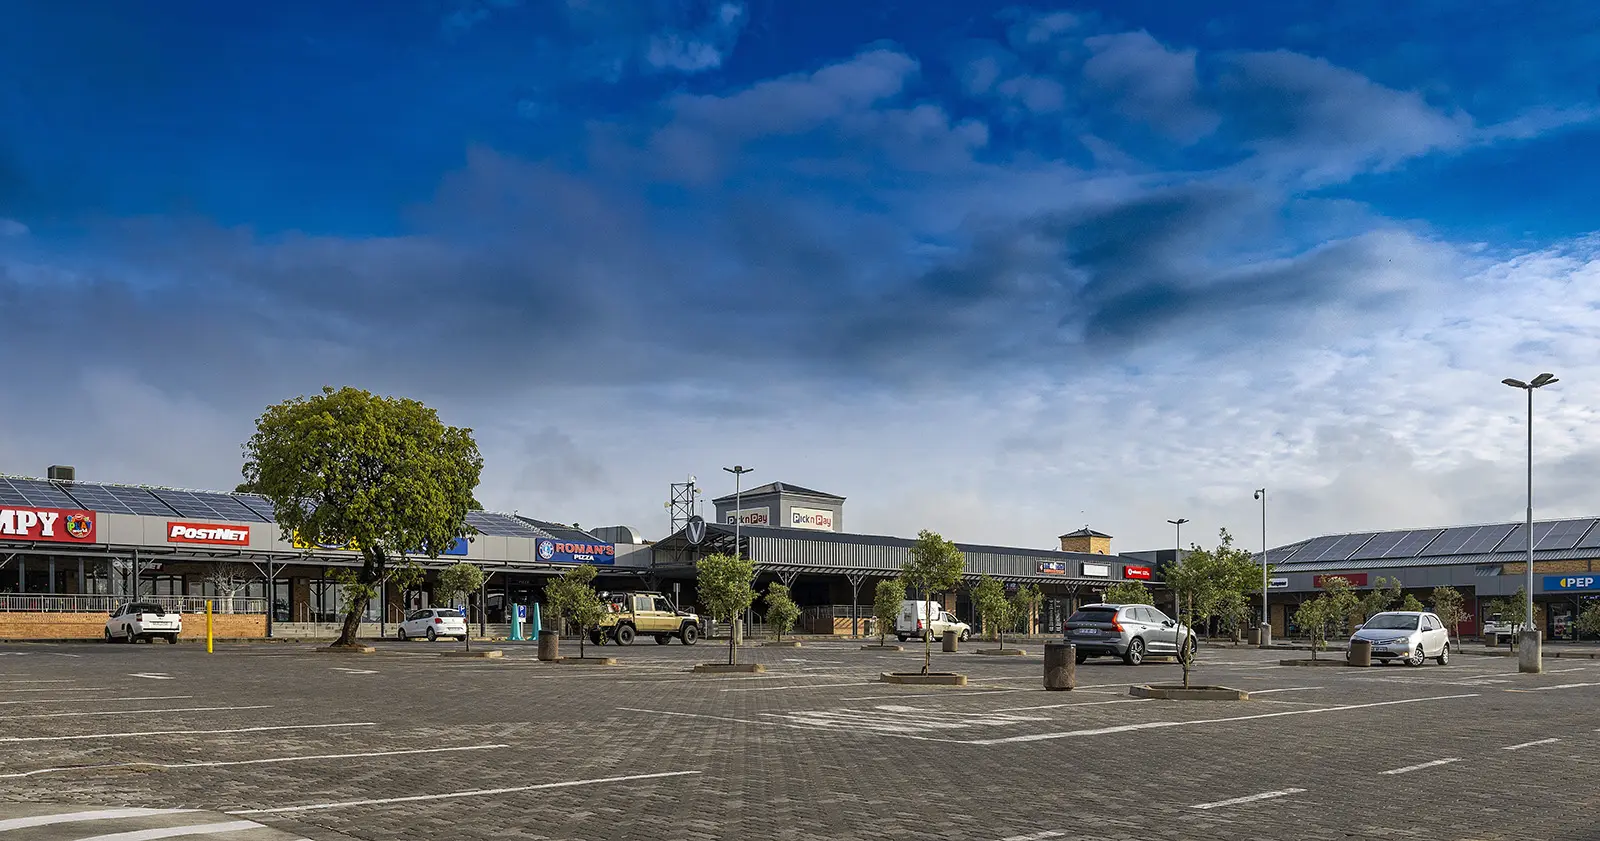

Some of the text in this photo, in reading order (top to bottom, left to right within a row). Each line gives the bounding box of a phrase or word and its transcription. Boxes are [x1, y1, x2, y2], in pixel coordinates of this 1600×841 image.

[750, 513, 768, 524] Pay
[792, 512, 810, 524] Pick
[815, 514, 832, 527] Pay
[68, 521, 93, 531] PLAY
[688, 520, 703, 543] V
[555, 543, 615, 556] ROMAN'S
[1566, 577, 1594, 588] PEP
